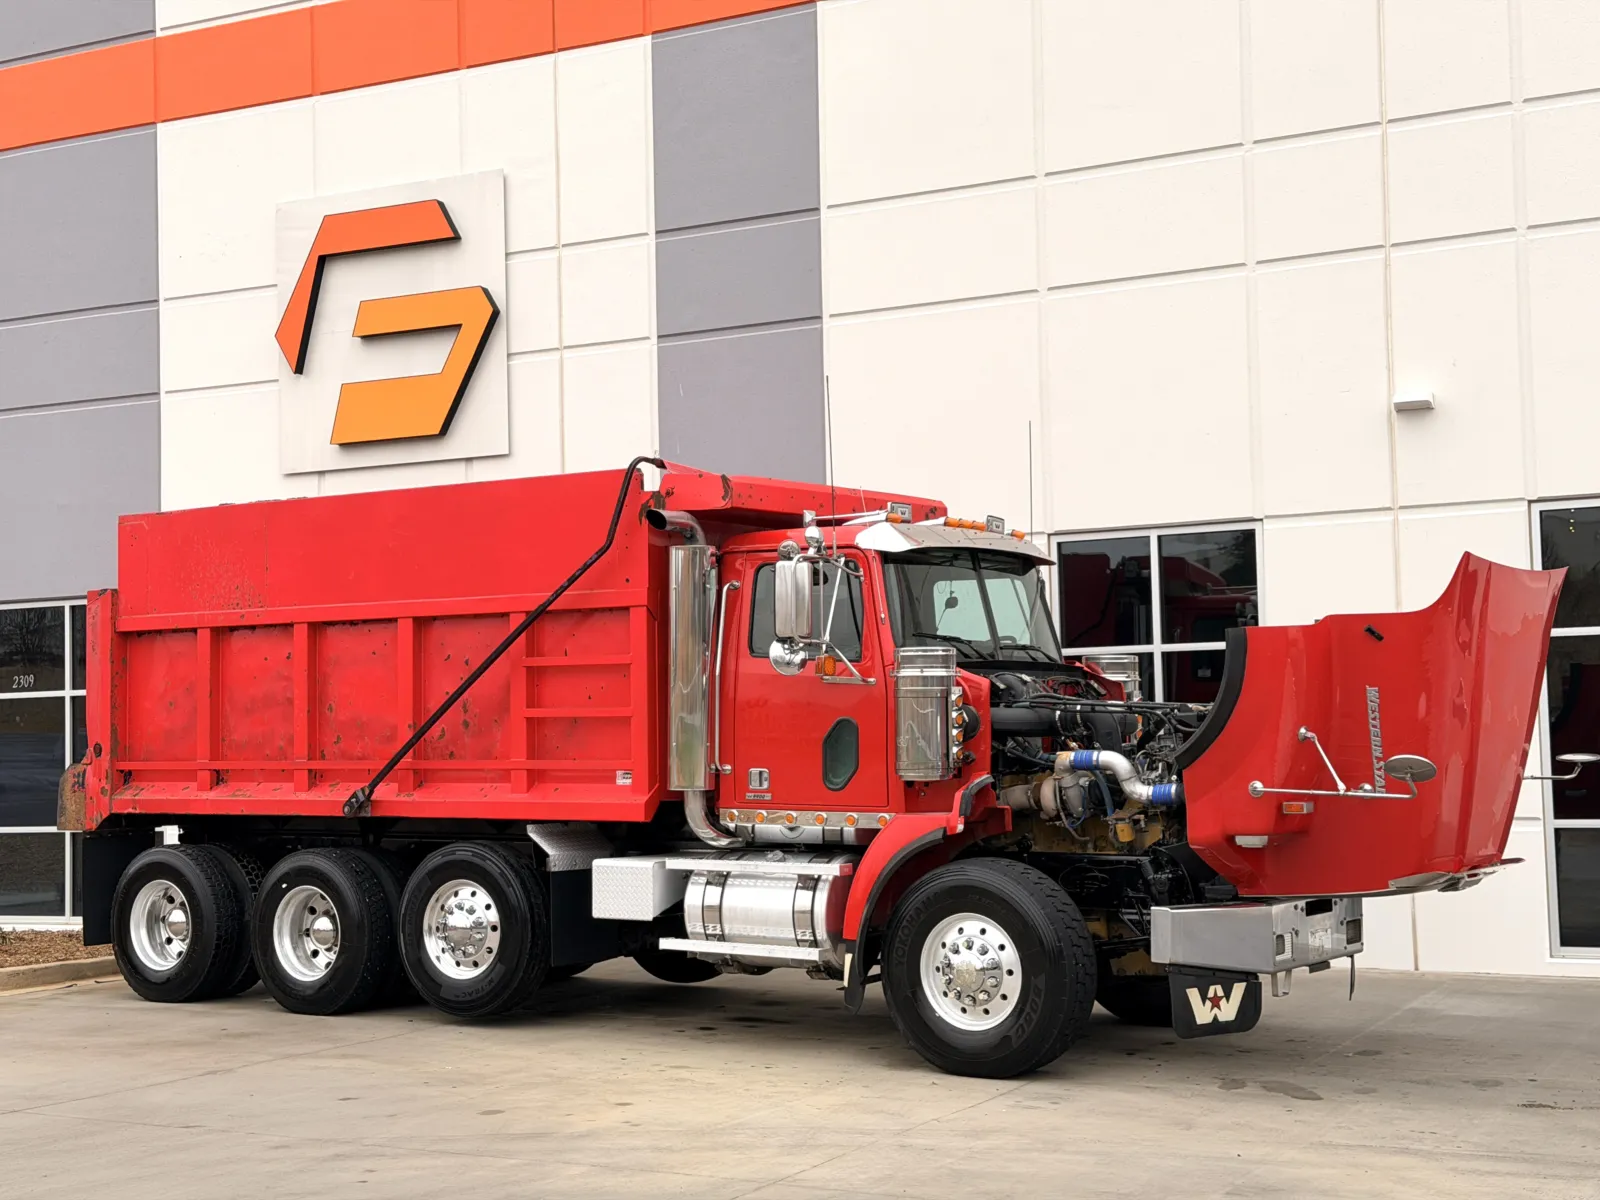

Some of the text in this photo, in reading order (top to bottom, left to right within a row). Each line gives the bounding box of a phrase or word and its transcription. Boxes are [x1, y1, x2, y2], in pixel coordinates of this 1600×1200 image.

[12, 674, 35, 689] 2309
[1365, 685, 1384, 760] WESTERN
[1185, 982, 1248, 1026] W
